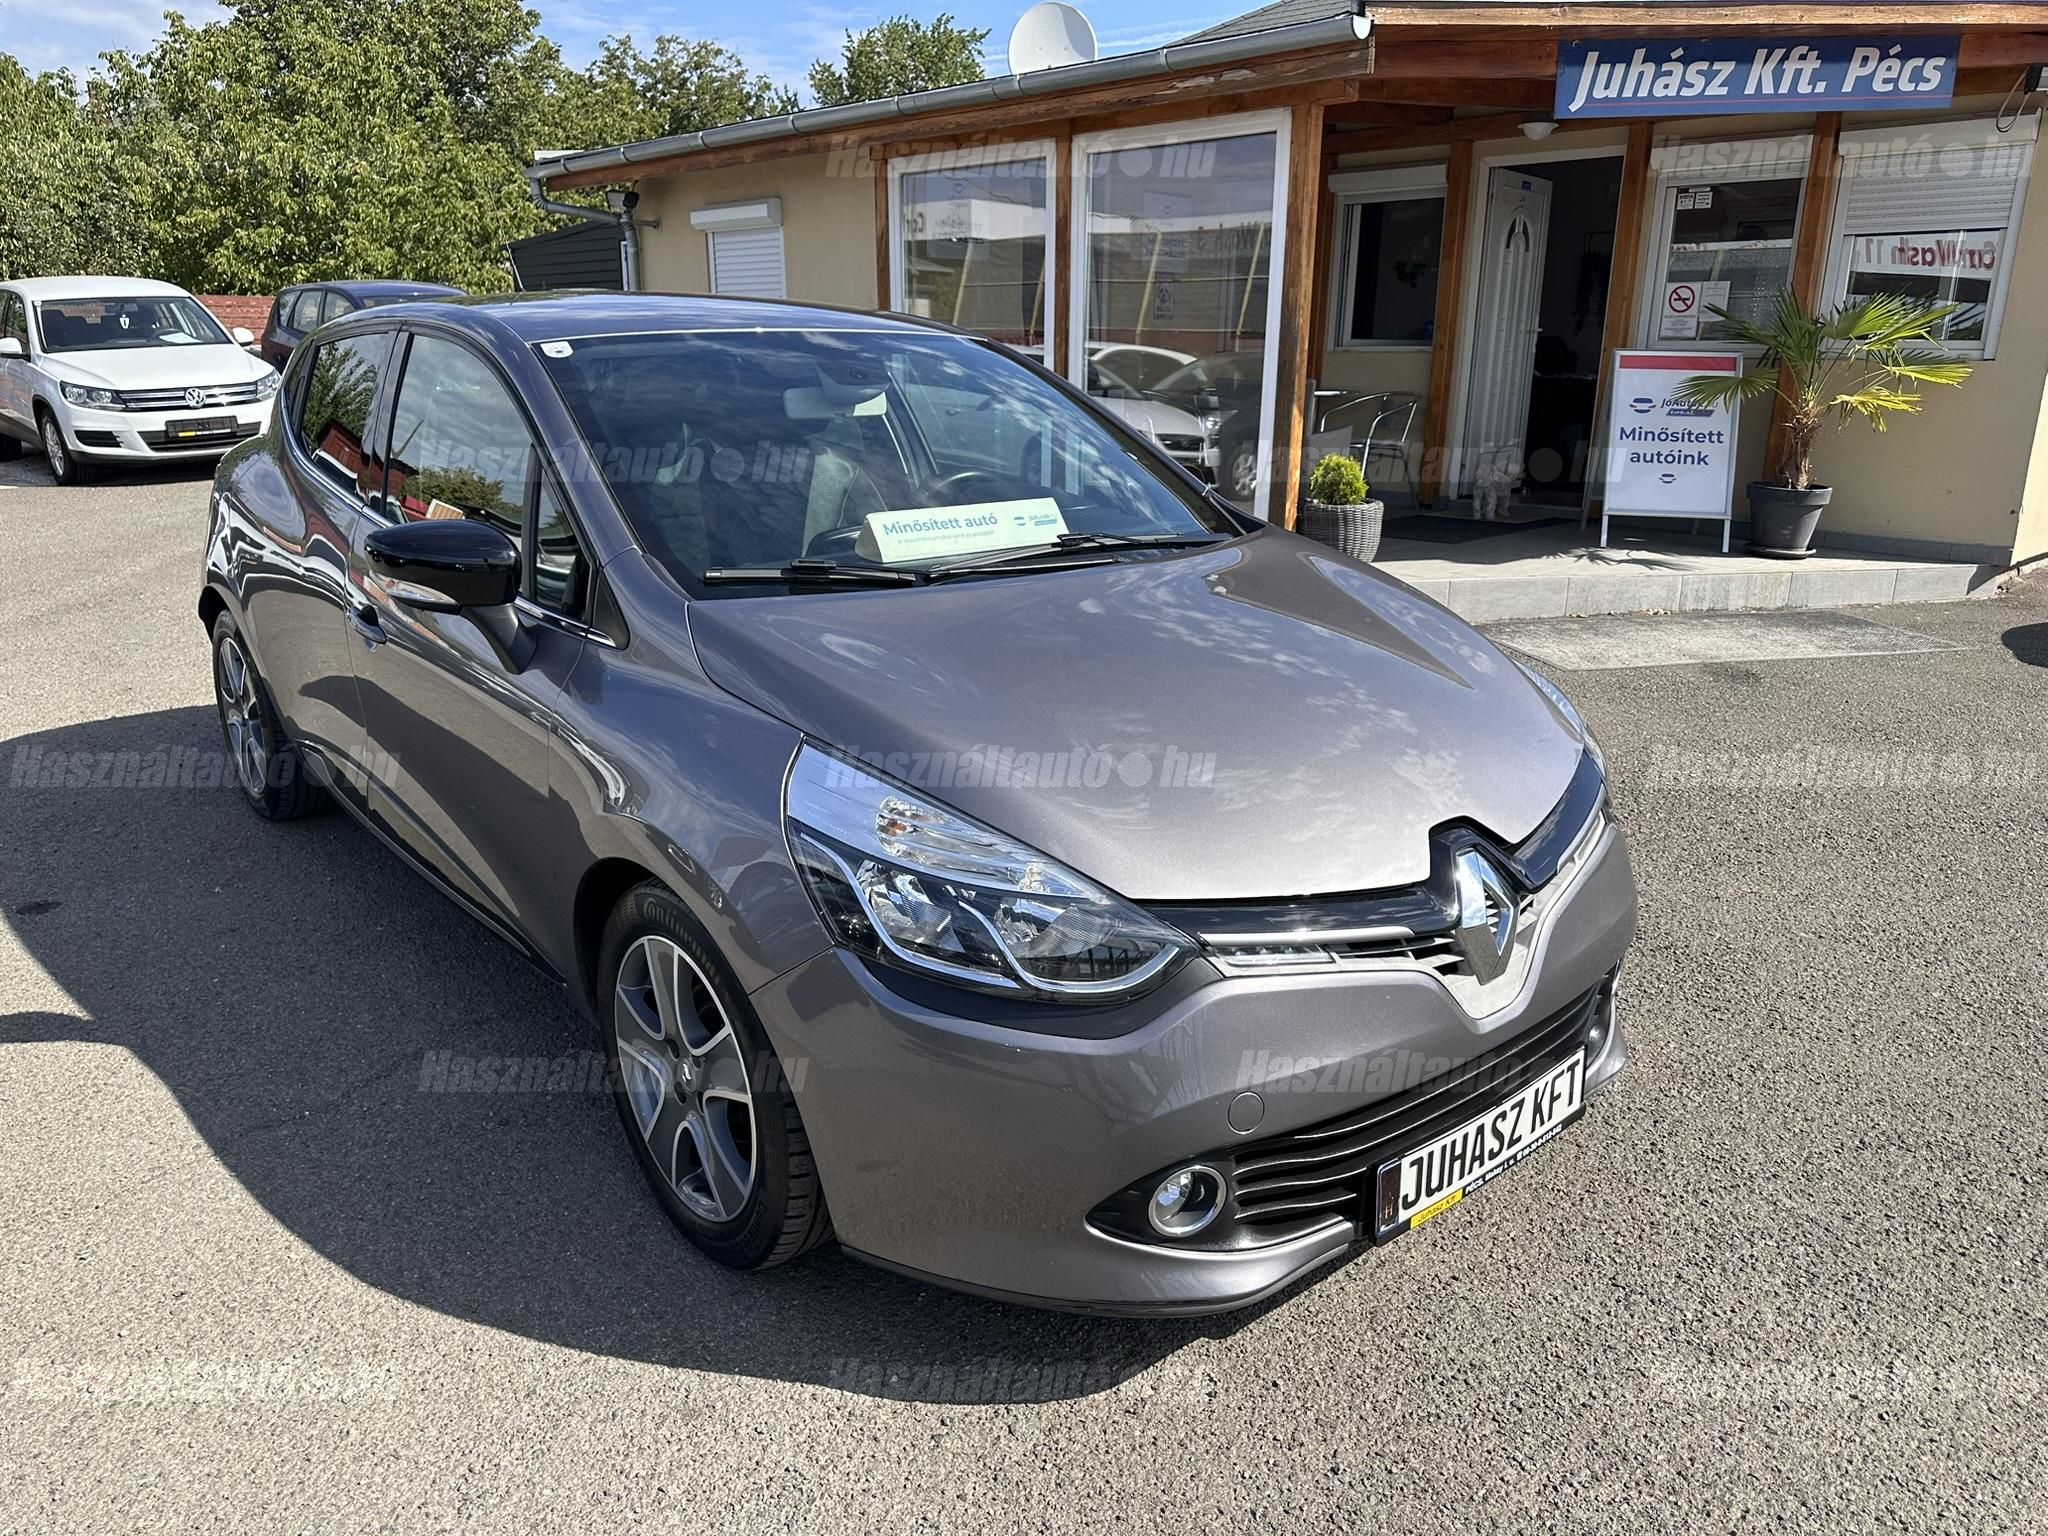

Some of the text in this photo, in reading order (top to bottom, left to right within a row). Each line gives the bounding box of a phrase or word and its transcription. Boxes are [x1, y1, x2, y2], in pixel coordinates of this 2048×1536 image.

[1568, 44, 1945, 112] Juhász Kft. Pécs
[1619, 426, 1724, 444] Minősített
[1630, 450, 1709, 466] autóink
[883, 512, 998, 535] Minősített autó
[1401, 1060, 1580, 1211] JUHASZ KFT
